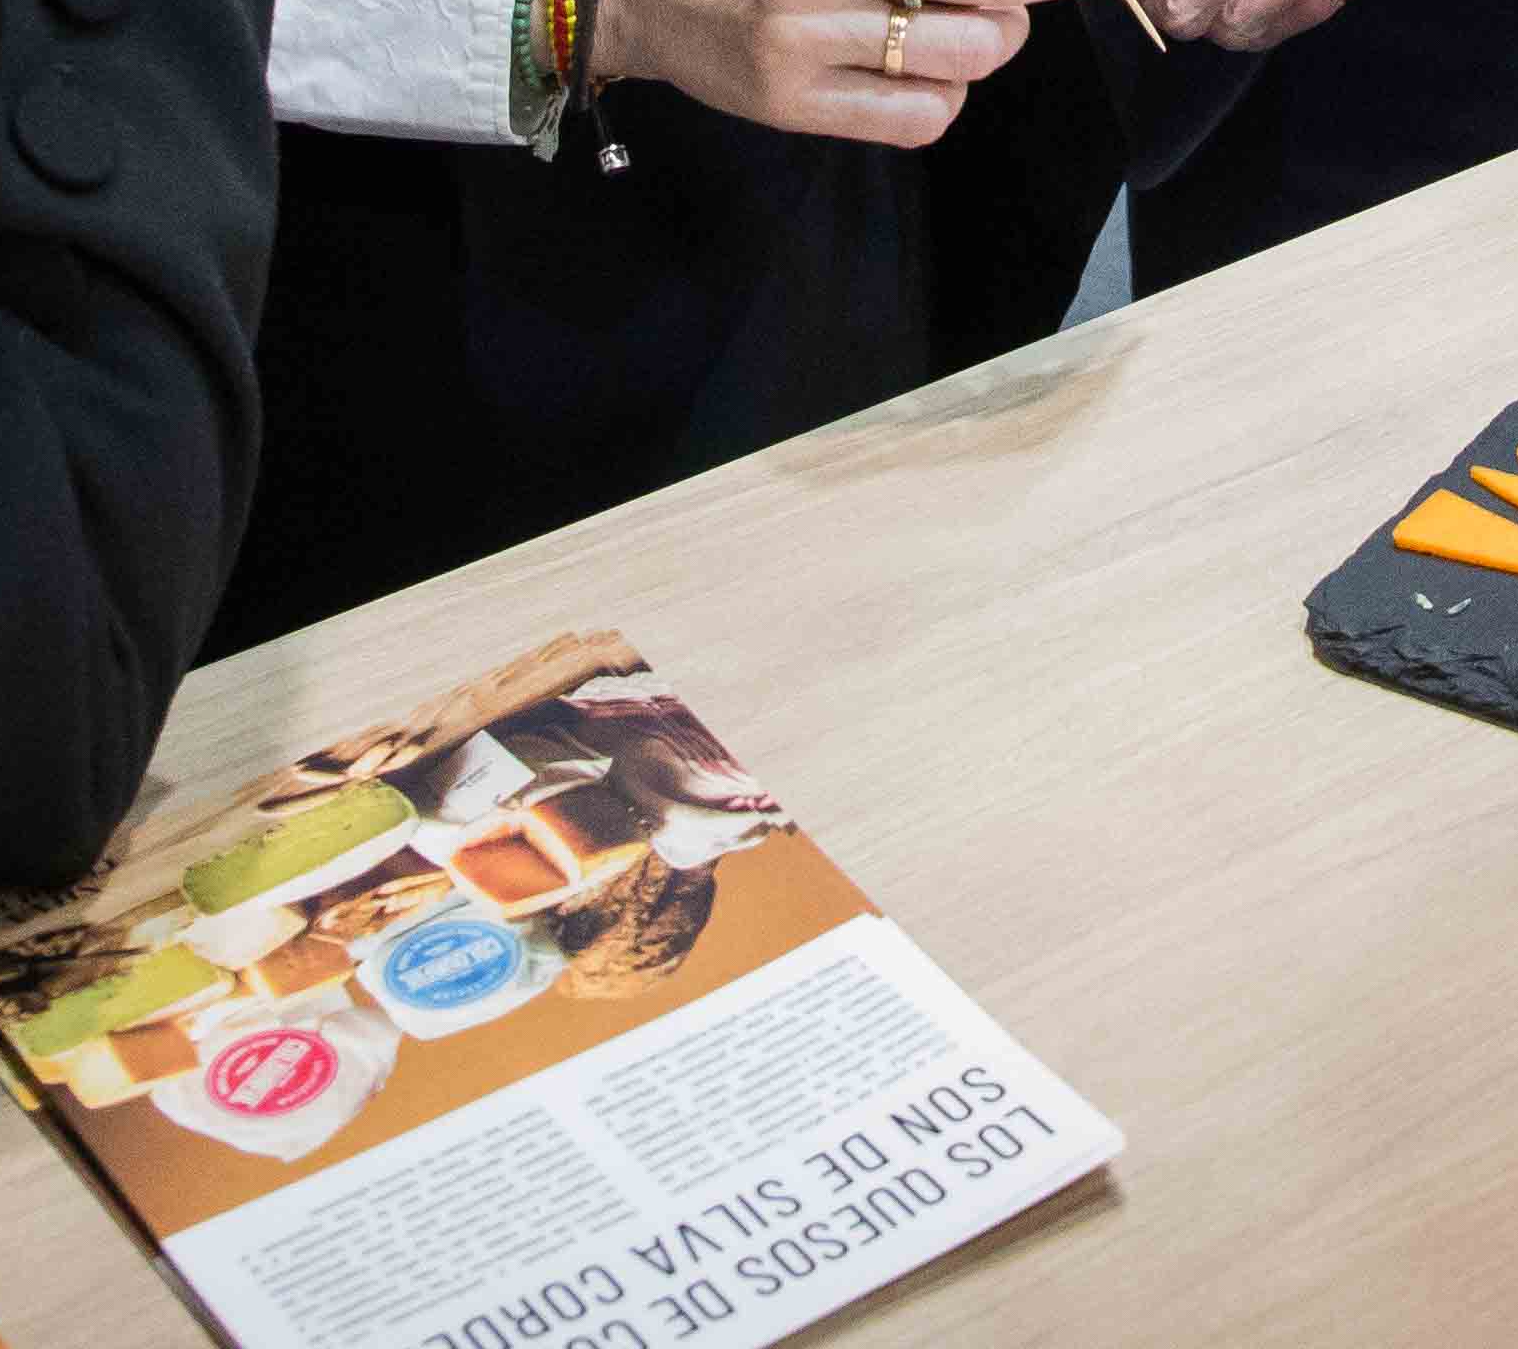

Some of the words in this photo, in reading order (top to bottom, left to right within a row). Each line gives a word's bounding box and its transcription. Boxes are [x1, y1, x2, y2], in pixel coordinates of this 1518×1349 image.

[887, 1066, 1007, 1146] SON
[946, 1105, 1056, 1179] LOS
[803, 1132, 890, 1194] DE
[629, 1177, 803, 1279] SILVA
[735, 1168, 948, 1296] QUESOS
[648, 1277, 736, 1338] DE
